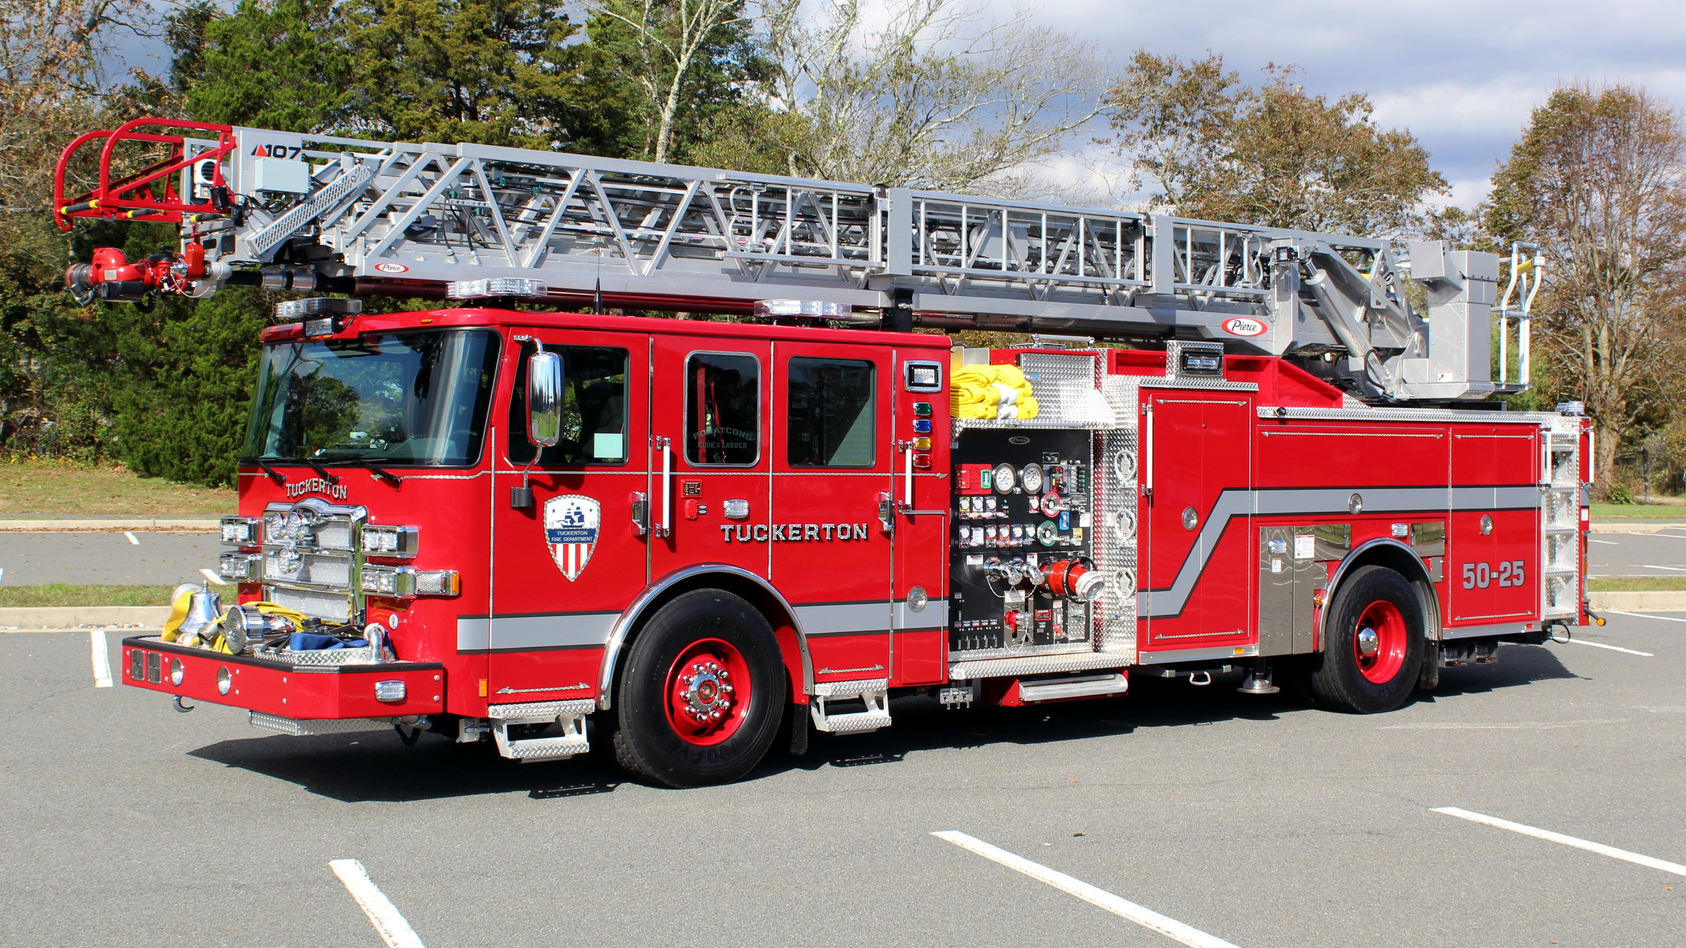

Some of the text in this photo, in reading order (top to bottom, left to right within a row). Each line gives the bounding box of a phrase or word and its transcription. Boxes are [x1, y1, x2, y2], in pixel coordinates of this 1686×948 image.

[265, 143, 302, 160] 107
[1231, 319, 1258, 332] Pierce
[285, 478, 347, 499] TUCKERTON
[720, 522, 868, 542] TUCKERTON
[1462, 560, 1525, 590] 50-25
